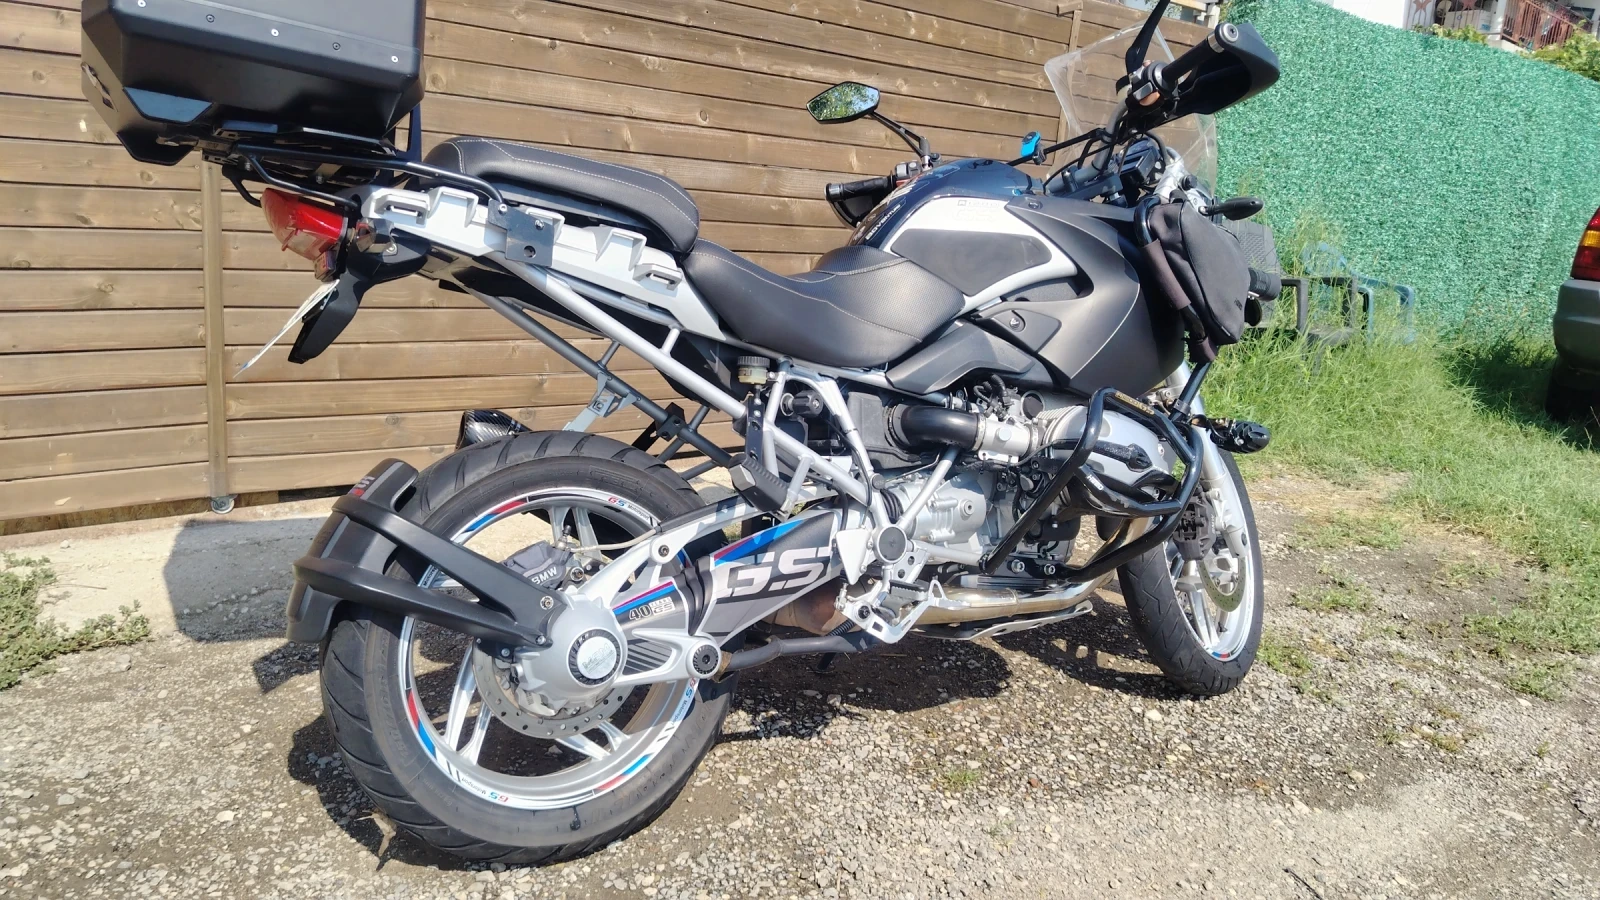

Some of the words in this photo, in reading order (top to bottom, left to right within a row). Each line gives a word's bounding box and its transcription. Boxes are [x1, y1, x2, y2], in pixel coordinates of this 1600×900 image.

[607, 496, 627, 507] GS
[627, 504, 650, 521] Motorsport
[531, 566, 558, 585] BMW
[713, 546, 832, 598] GS
[629, 604, 652, 621] 40
[653, 602, 674, 614] GS
[685, 676, 697, 699] GS
[461, 777, 487, 795] Motorsport
[488, 791, 509, 803] GS
